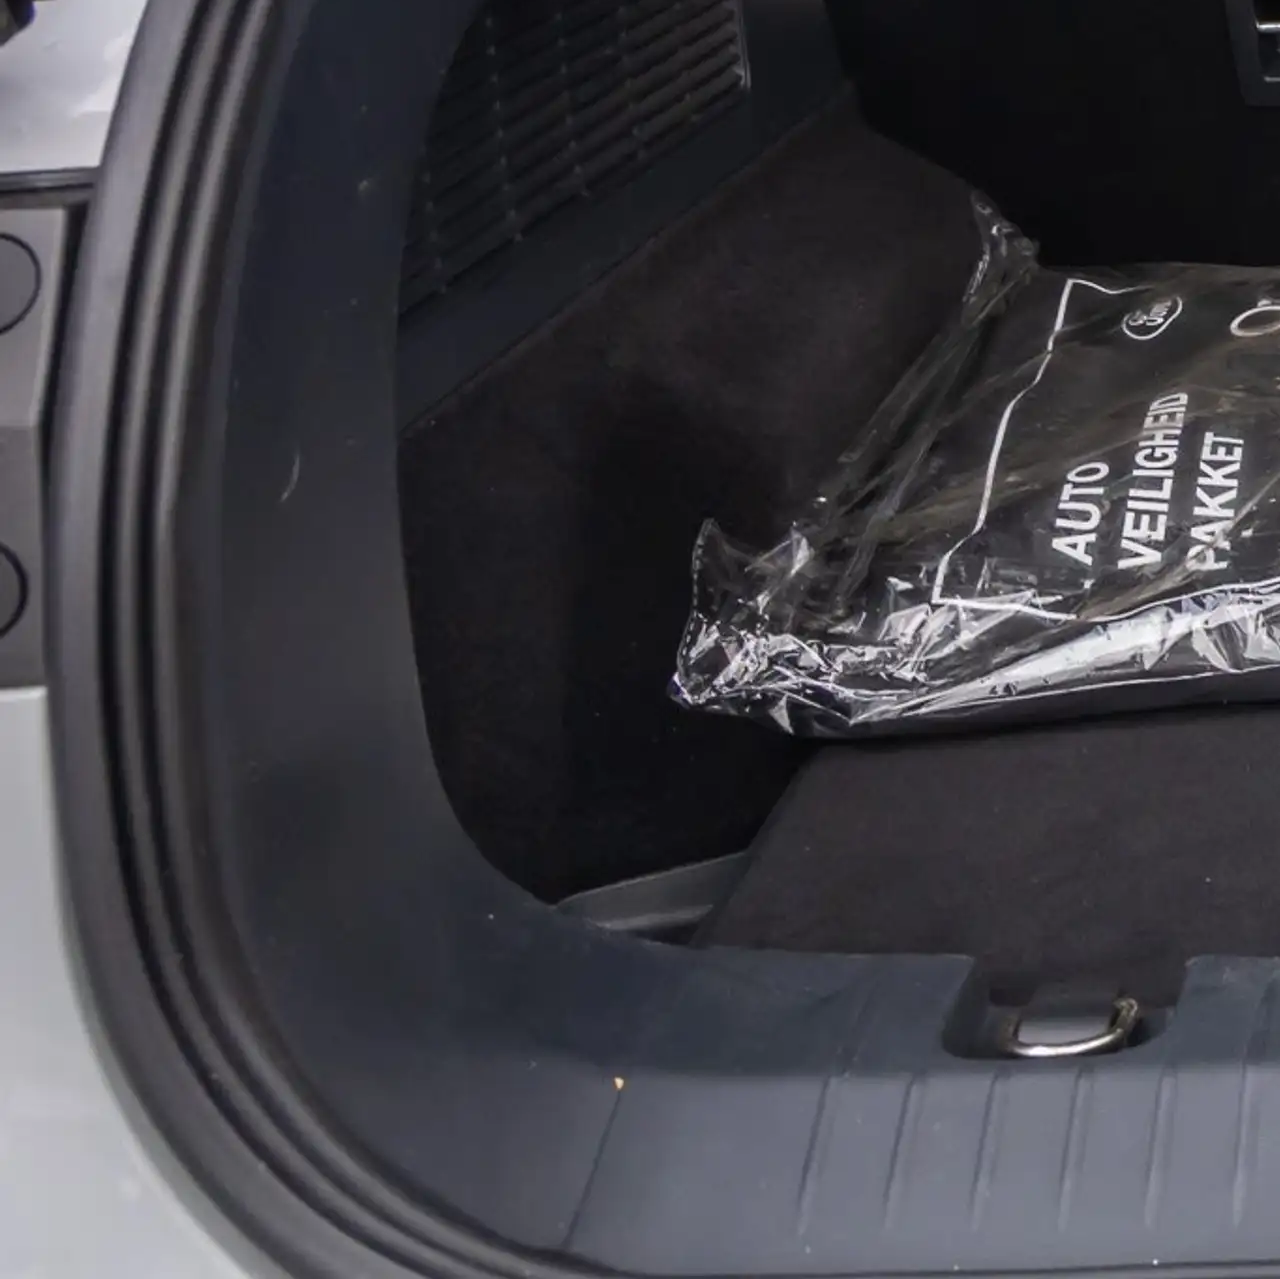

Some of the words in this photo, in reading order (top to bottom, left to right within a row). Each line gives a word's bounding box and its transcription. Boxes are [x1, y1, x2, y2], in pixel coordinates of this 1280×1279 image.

[1052, 461, 1109, 566] AUTO
[1117, 392, 1188, 569] VEILIGHEID
[1186, 431, 1244, 570] PAKKET
